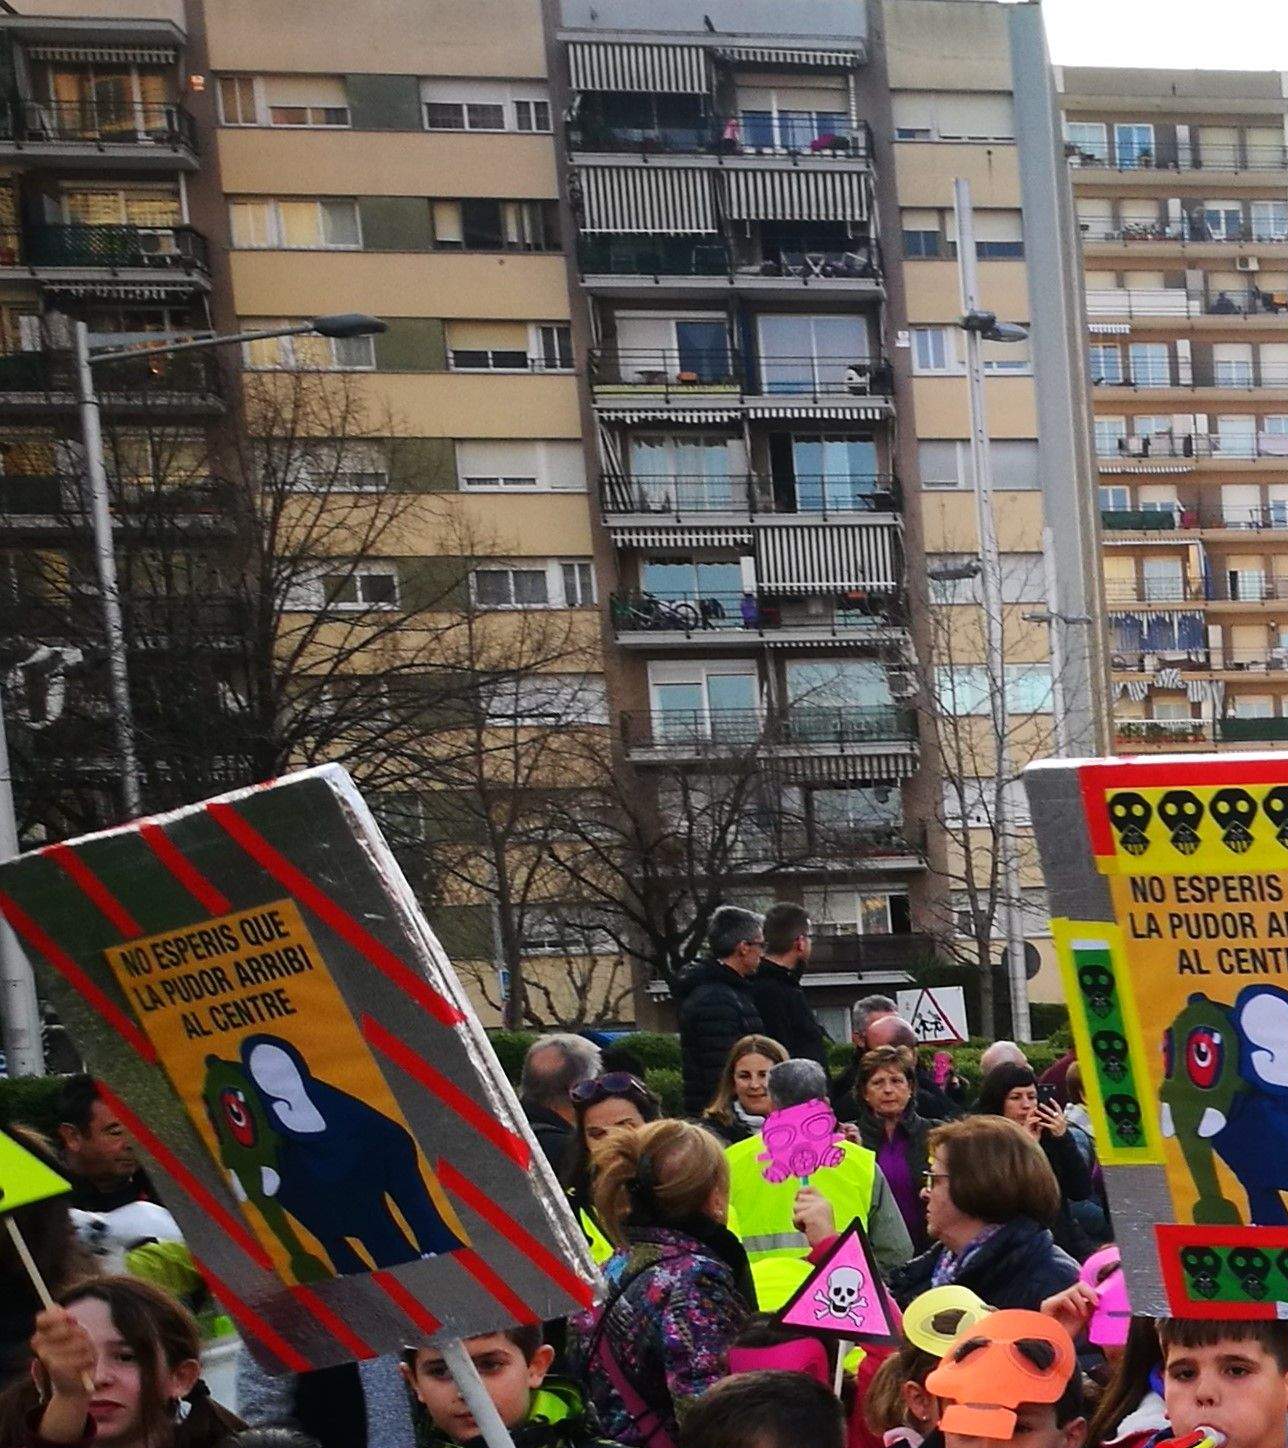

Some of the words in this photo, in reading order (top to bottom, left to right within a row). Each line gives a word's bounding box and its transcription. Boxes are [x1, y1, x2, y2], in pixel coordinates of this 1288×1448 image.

[1130, 875, 1166, 905] NO
[1173, 873, 1282, 904] ESPERIS
[120, 946, 153, 978] NO
[151, 924, 240, 971] ESPERIS
[239, 910, 291, 947] QUE
[1129, 911, 1163, 939] LA
[1170, 911, 1259, 940] PUDOR
[132, 984, 167, 1013] LA
[159, 966, 234, 1006] PUDOR
[233, 944, 314, 988] ARRIBI
[1178, 947, 1212, 975] AL
[181, 1011, 213, 1040] AL
[209, 988, 298, 1033] CENTRE
